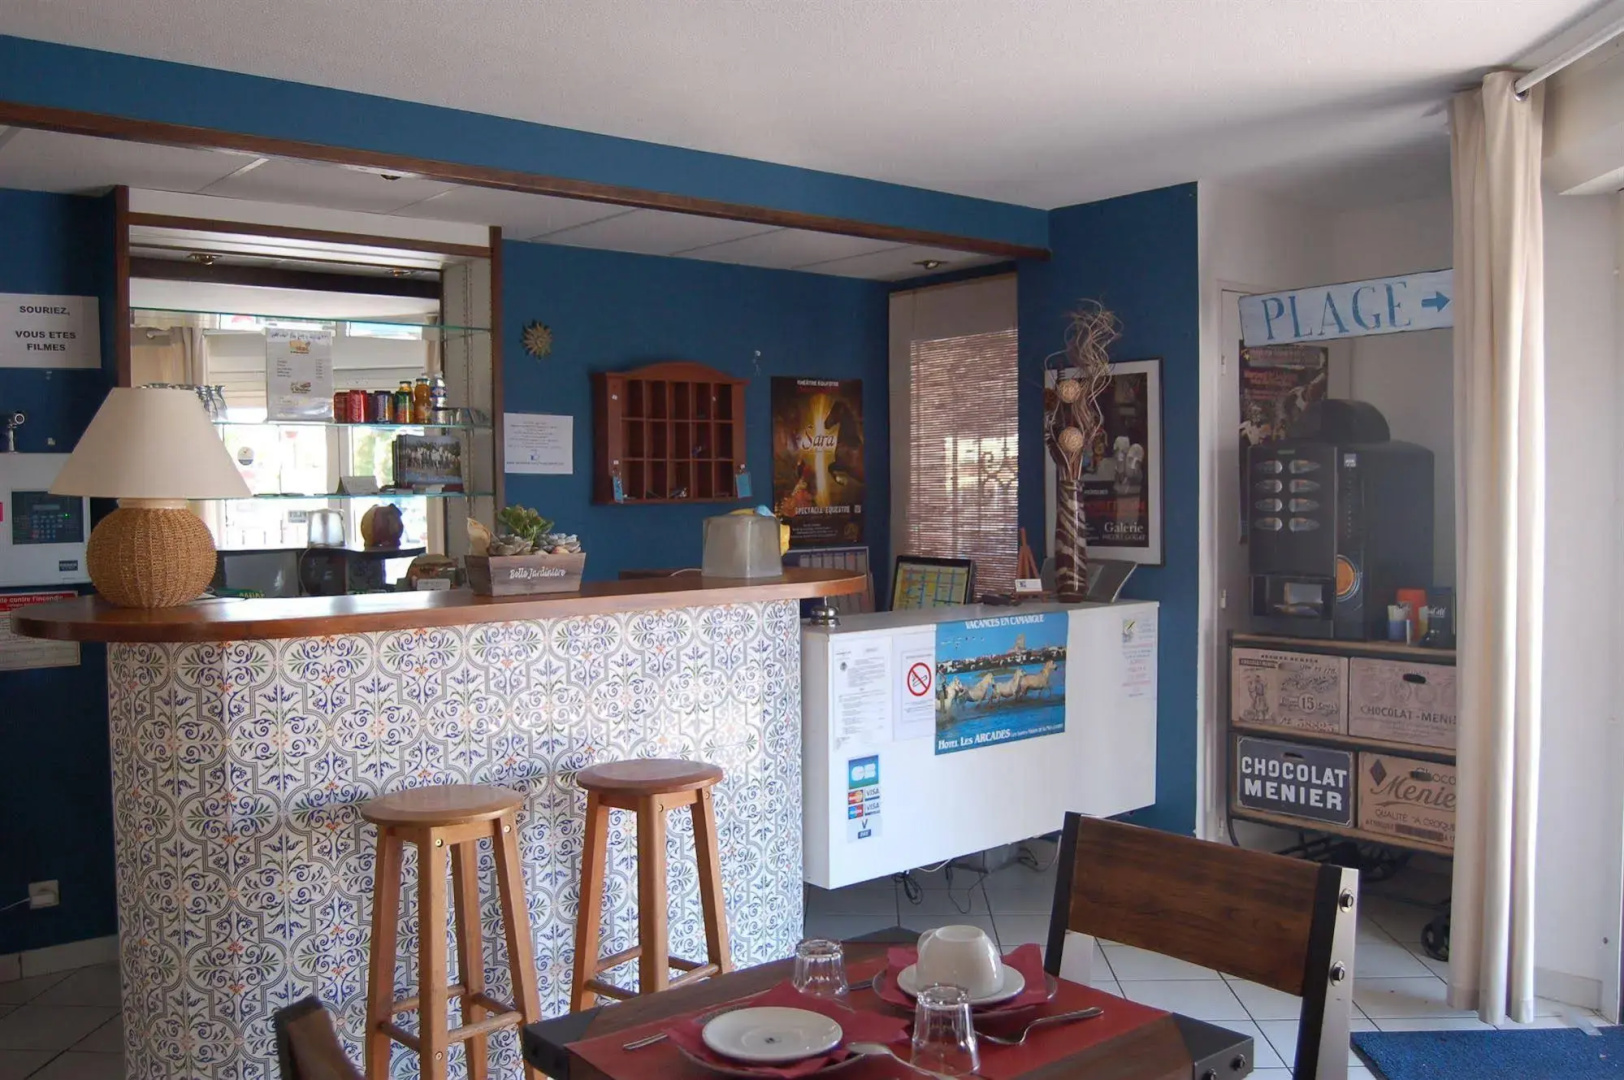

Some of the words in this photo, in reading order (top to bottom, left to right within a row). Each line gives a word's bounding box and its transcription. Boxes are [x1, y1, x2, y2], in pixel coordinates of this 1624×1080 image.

[19, 305, 70, 316] SOURIEZ,
[1261, 281, 1411, 340] PLAGE
[15, 330, 46, 339] VOUS
[49, 331, 76, 340] ETES
[27, 343, 66, 352] FILMES
[802, 425, 834, 450] Sara
[1104, 521, 1144, 533] Galerie
[965, 618, 1000, 630] VACANCES
[1000, 617, 1010, 627] EN
[1010, 613, 1045, 626] CAMARGUE
[1302, 696, 1315, 710] 15
[1360, 705, 1413, 720] CHOCOLAT
[974, 728, 1011, 743] ARCADES
[1241, 756, 1347, 788] CHOCOLAT
[866, 787, 880, 797] VISA
[1244, 778, 1342, 811] MENIER
[866, 802, 880, 811] VISA
